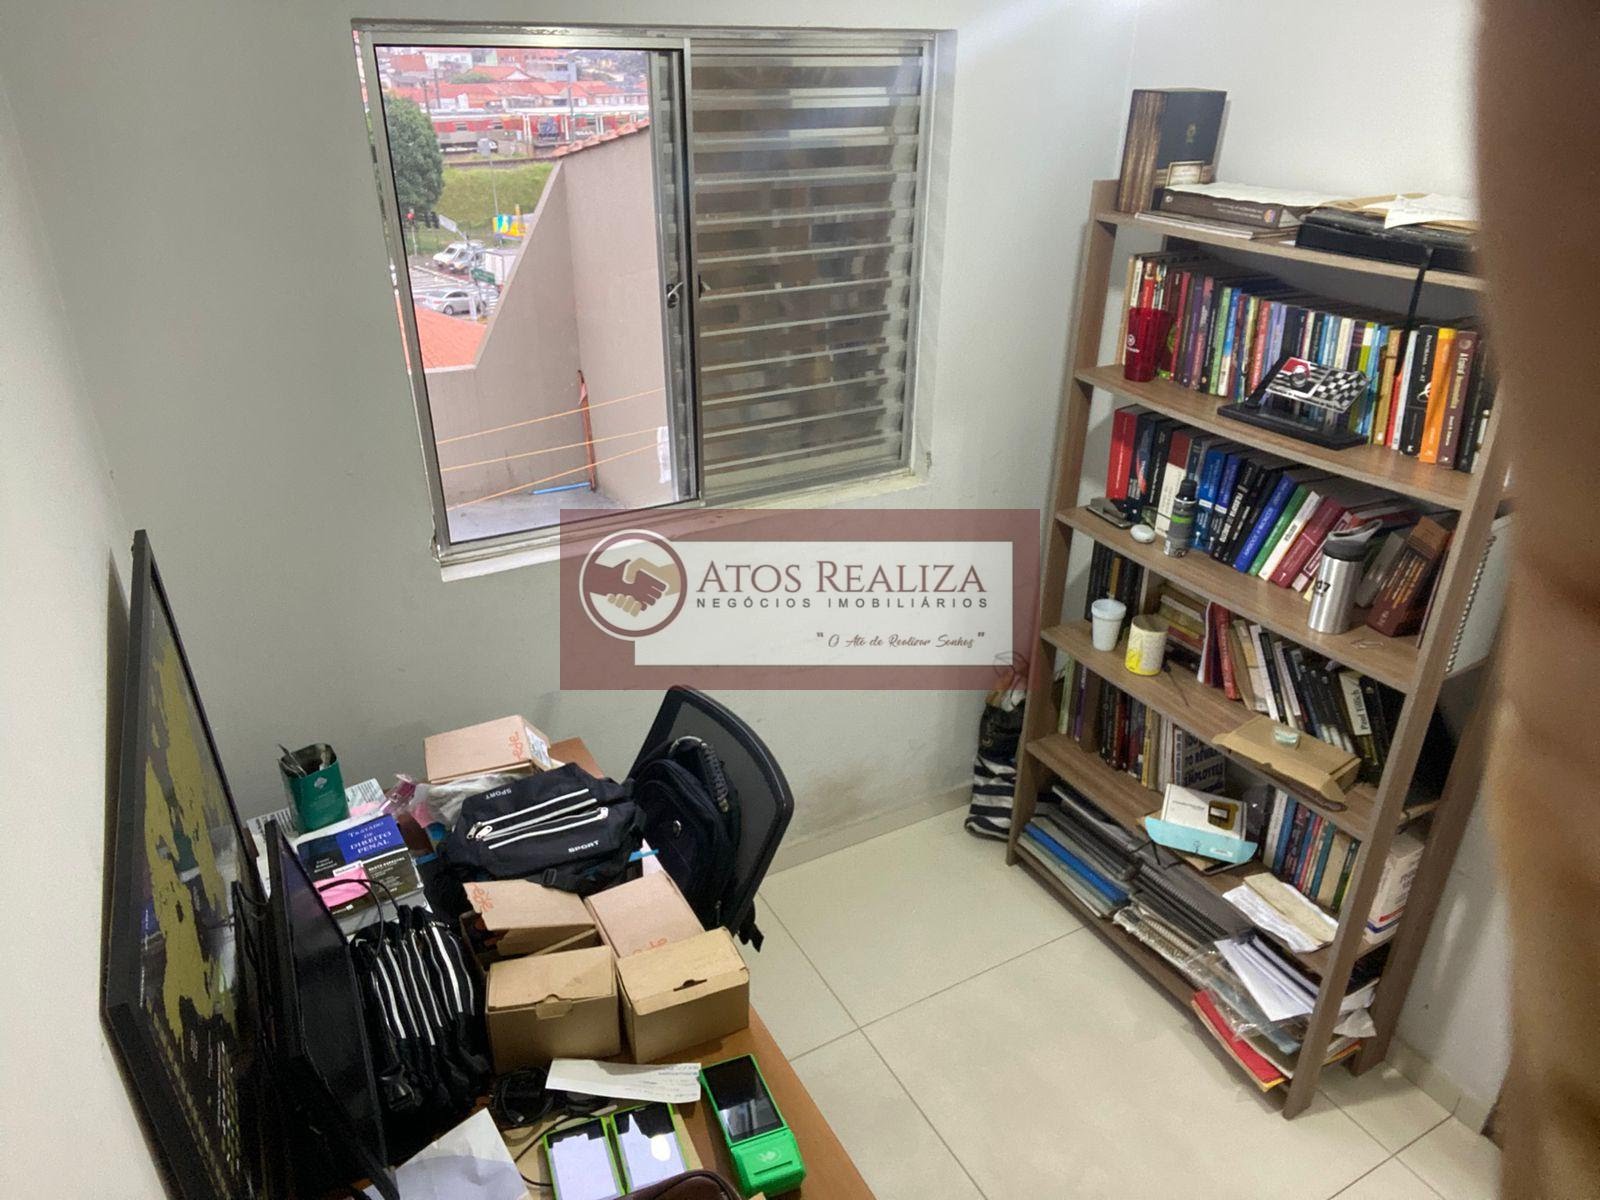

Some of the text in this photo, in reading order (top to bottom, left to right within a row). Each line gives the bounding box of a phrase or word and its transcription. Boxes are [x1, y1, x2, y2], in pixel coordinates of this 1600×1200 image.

[1358, 713, 1369, 730] Paul
[485, 788, 512, 800] SPORT
[350, 831, 392, 850] DIREITO
[357, 840, 390, 854] PENAL
[568, 839, 600, 853] SPORT
